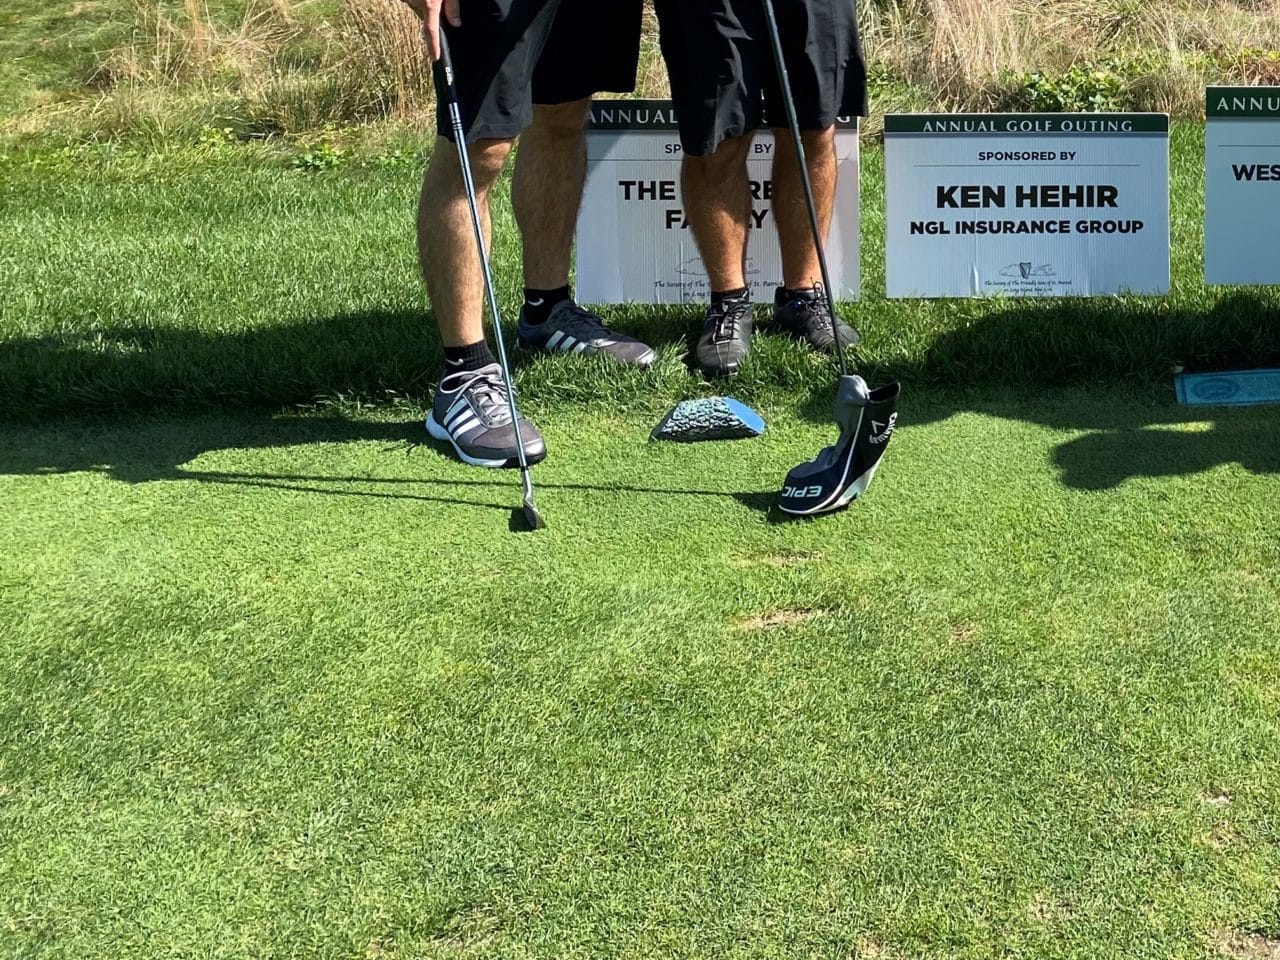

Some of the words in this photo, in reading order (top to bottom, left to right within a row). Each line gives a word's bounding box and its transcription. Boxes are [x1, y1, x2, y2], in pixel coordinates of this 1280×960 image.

[586, 109, 678, 124] ANNUAL
[923, 120, 997, 132] ANNUAL
[1006, 120, 1052, 132] GOLF
[1060, 120, 1133, 132] OUTING
[754, 143, 772, 154] BY
[978, 151, 1056, 161] SPONSORED
[1060, 151, 1076, 161] BY
[618, 180, 676, 200] THE
[937, 185, 1006, 208] KEN
[1016, 185, 1118, 208] HEHIR
[910, 221, 950, 235] NGL
[955, 220, 1070, 234] INSURANCE
[1076, 220, 1144, 234] GROUP
[781, 485, 823, 498] EPIC
